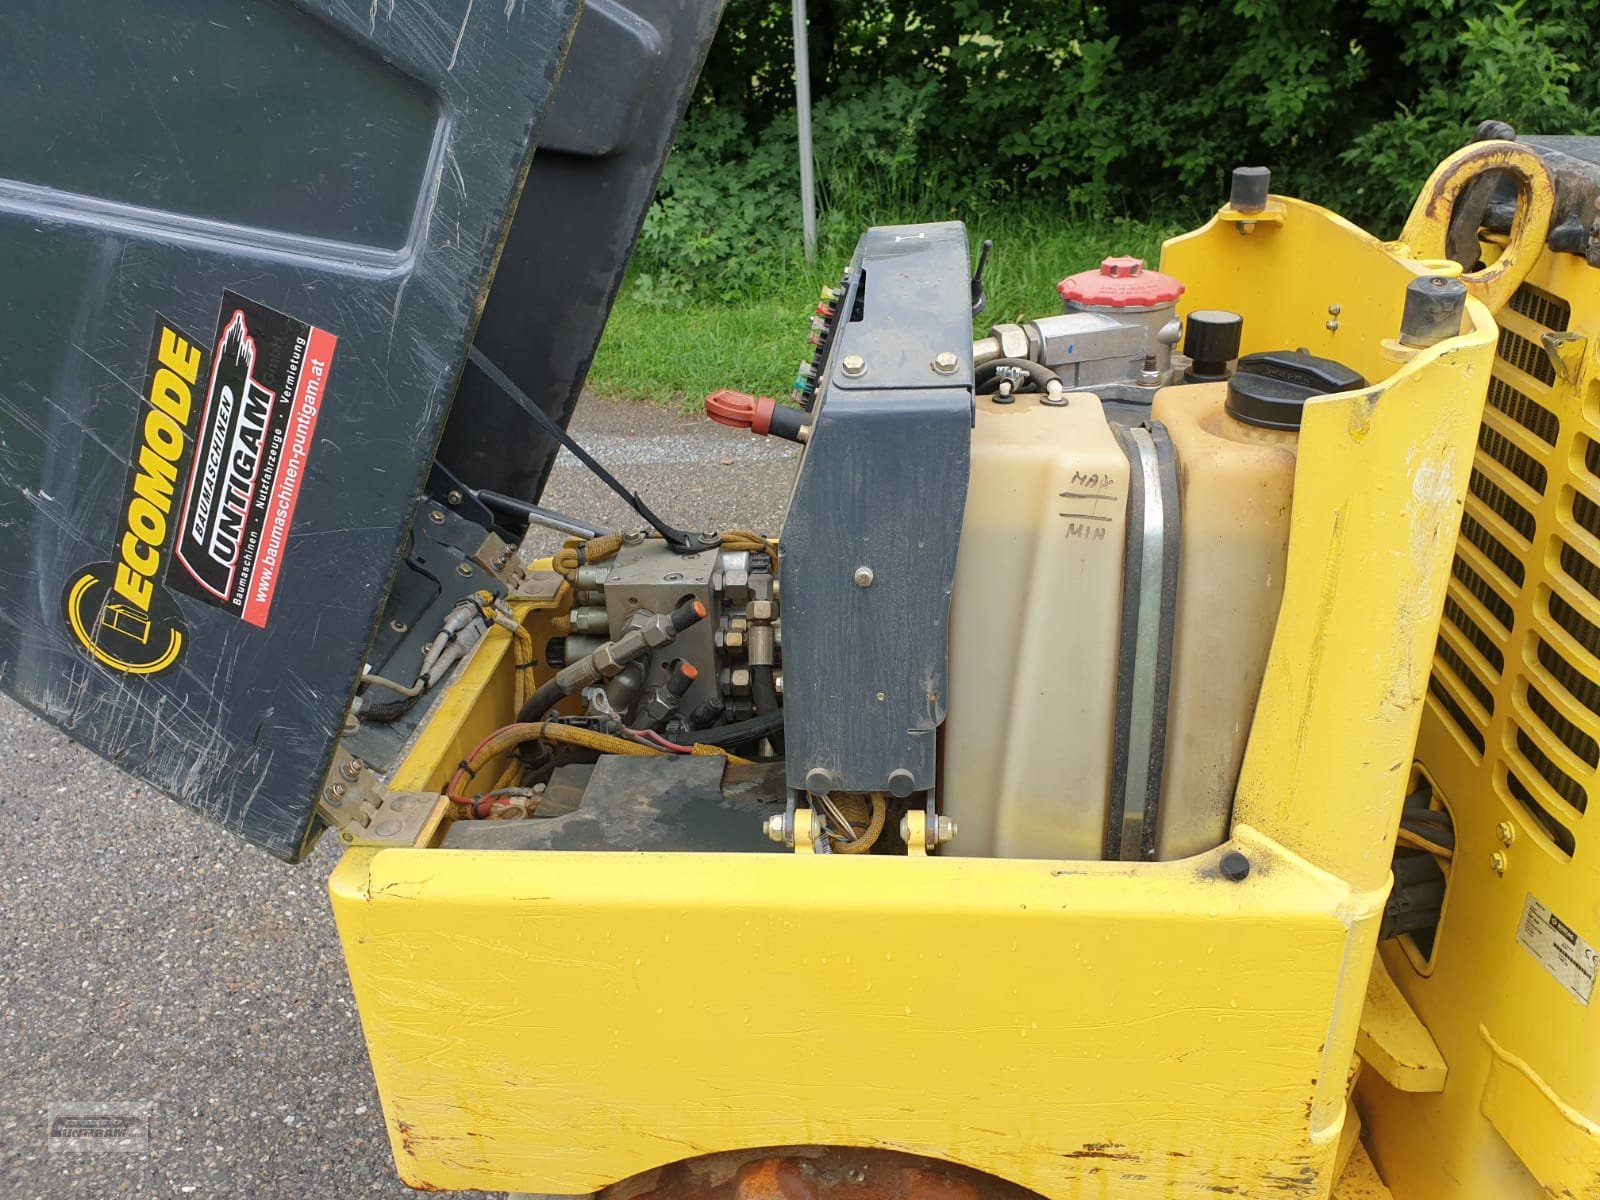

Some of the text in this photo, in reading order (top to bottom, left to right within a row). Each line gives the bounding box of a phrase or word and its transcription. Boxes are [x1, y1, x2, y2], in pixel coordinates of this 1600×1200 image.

[114, 326, 201, 612] ECOMODE
[195, 395, 232, 537] BAUMASCHINEN
[233, 337, 306, 606] Baumaschinen Nutzfahrzeuge Vermietung
[256, 358, 325, 603] www.baumaschinen-puntigam.at
[1065, 523, 1106, 541] MIN
